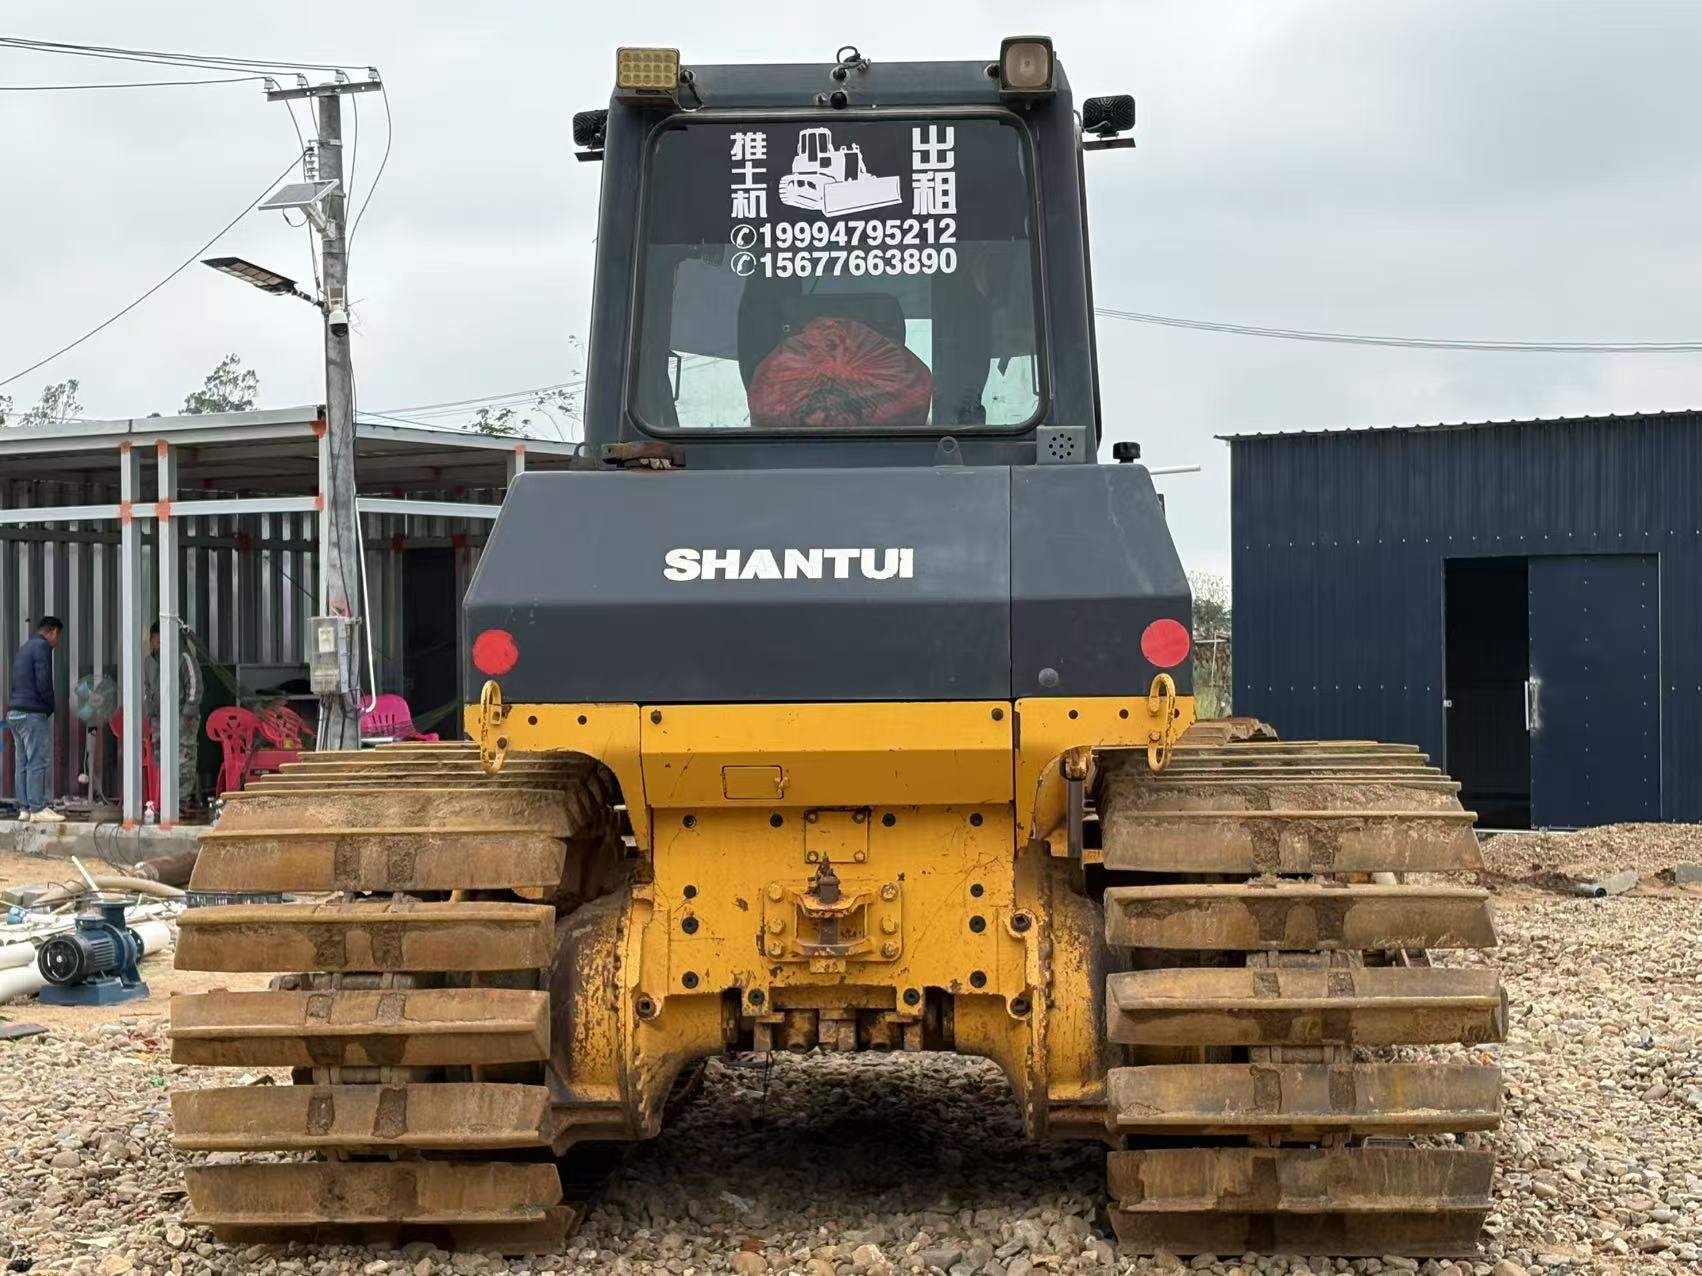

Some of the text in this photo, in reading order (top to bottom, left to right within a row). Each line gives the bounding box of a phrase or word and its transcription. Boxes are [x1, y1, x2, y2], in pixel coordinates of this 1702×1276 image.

[730, 131, 768, 219] 推土机
[911, 125, 957, 215] 出租
[759, 217, 957, 248] 19994795212
[760, 247, 958, 278] 15677663890
[663, 548, 914, 581] SHANTUI
